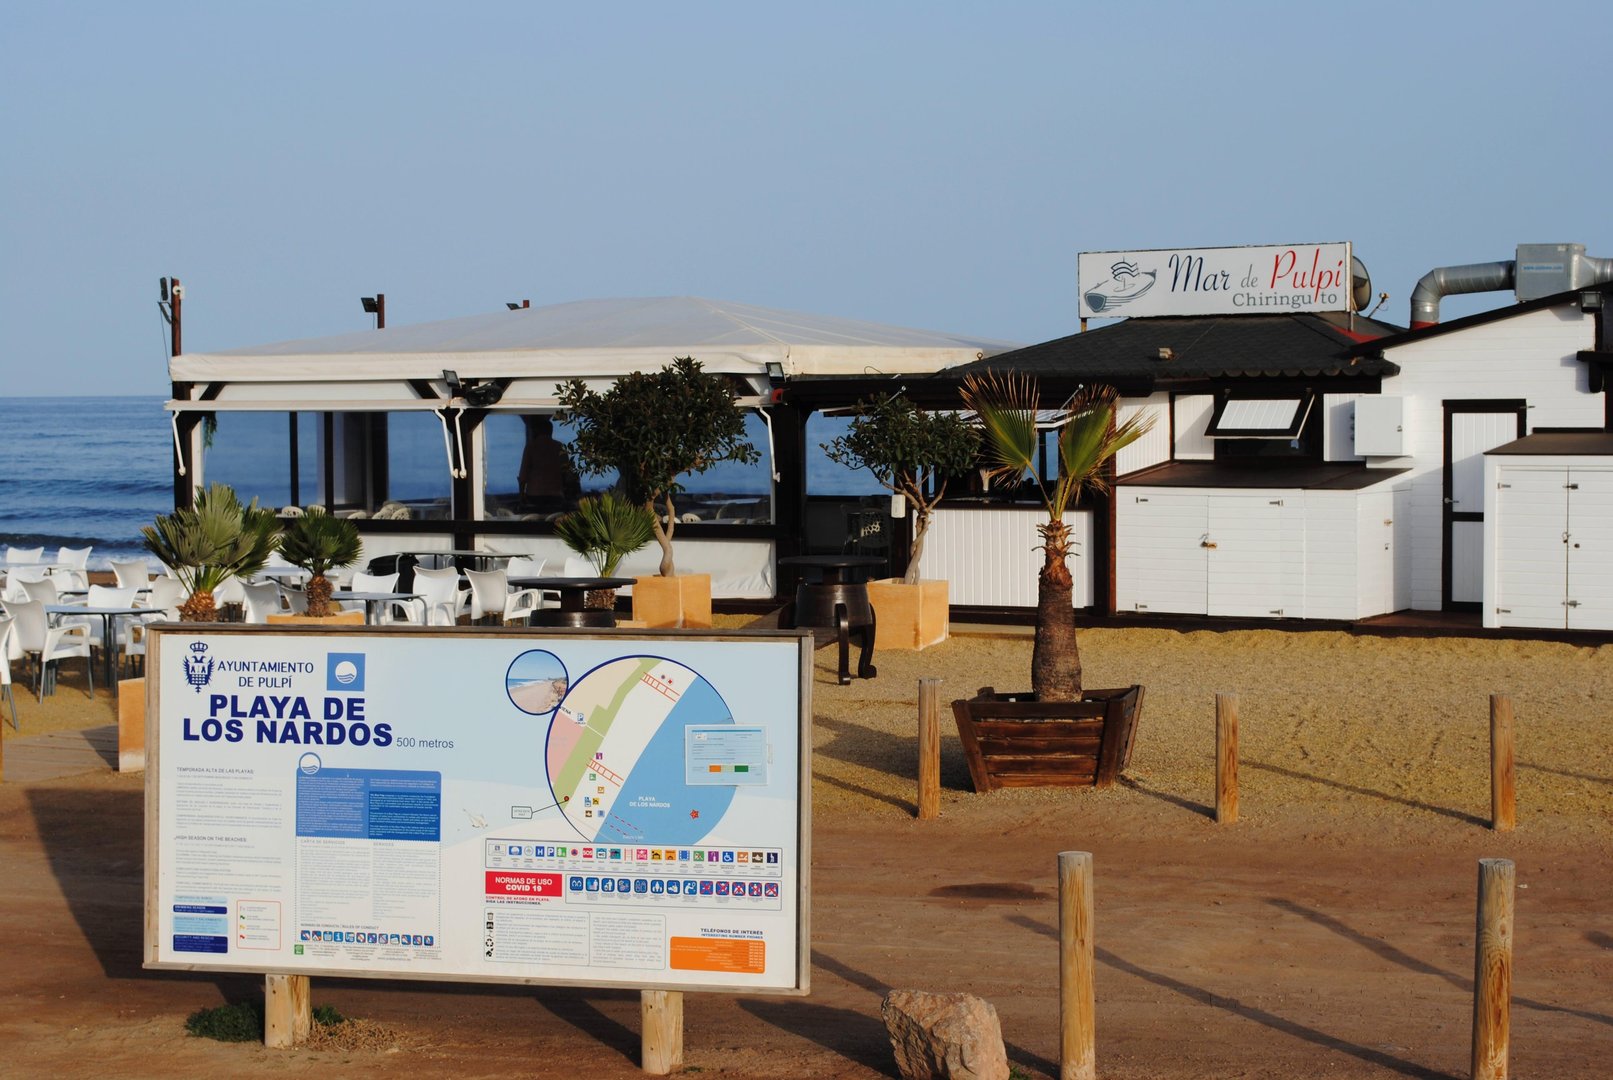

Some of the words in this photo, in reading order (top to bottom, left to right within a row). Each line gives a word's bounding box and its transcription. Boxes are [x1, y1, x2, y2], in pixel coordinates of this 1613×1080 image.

[1168, 253, 1230, 292] Mar
[1240, 264, 1258, 288] de
[217, 660, 314, 674] AYUNTAMIENTO
[238, 676, 254, 688] DE
[258, 675, 292, 688] PULPÍ
[210, 694, 312, 720] PLAYA
[324, 697, 366, 722] DE
[183, 718, 244, 742] LOS
[256, 721, 392, 748] NARDOS
[396, 737, 416, 748] 500
[418, 739, 454, 750] metros
[495, 876, 525, 884] NORMAS
